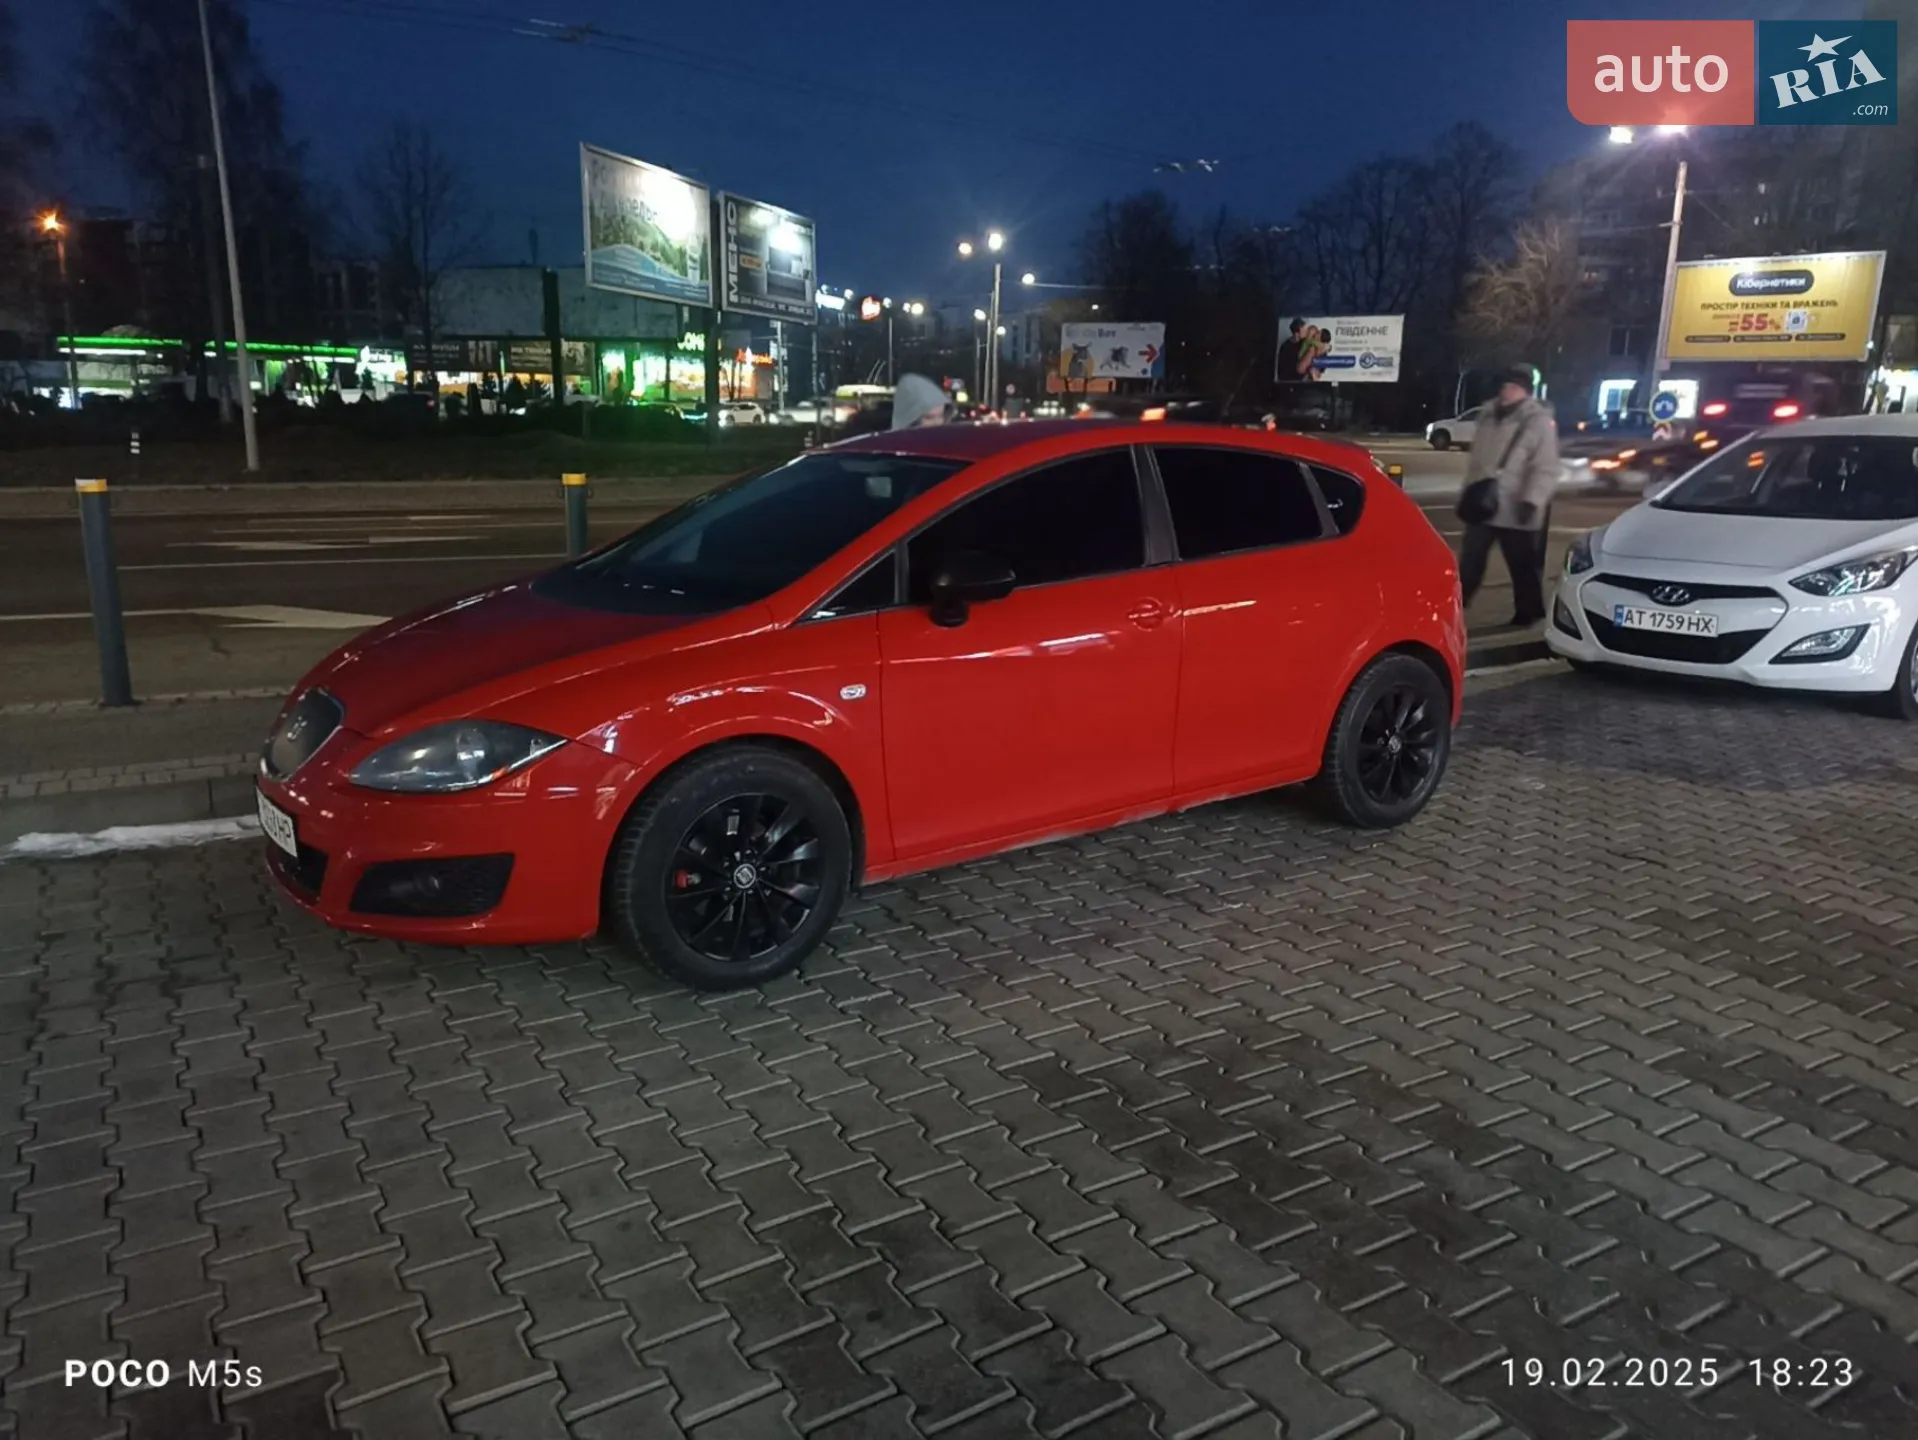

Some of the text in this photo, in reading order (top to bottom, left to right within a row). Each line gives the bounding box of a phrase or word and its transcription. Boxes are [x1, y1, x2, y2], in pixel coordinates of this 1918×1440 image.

[1737, 276, 1806, 289] Кібернетики
[1701, 299, 1838, 311] ПРОСТІР ТЕХНІКИ ТА ВРАЖЕНЬ
[1335, 325, 1389, 337] ПІВДЕННЕ
[1625, 609, 1712, 633] AT 1759 HX
